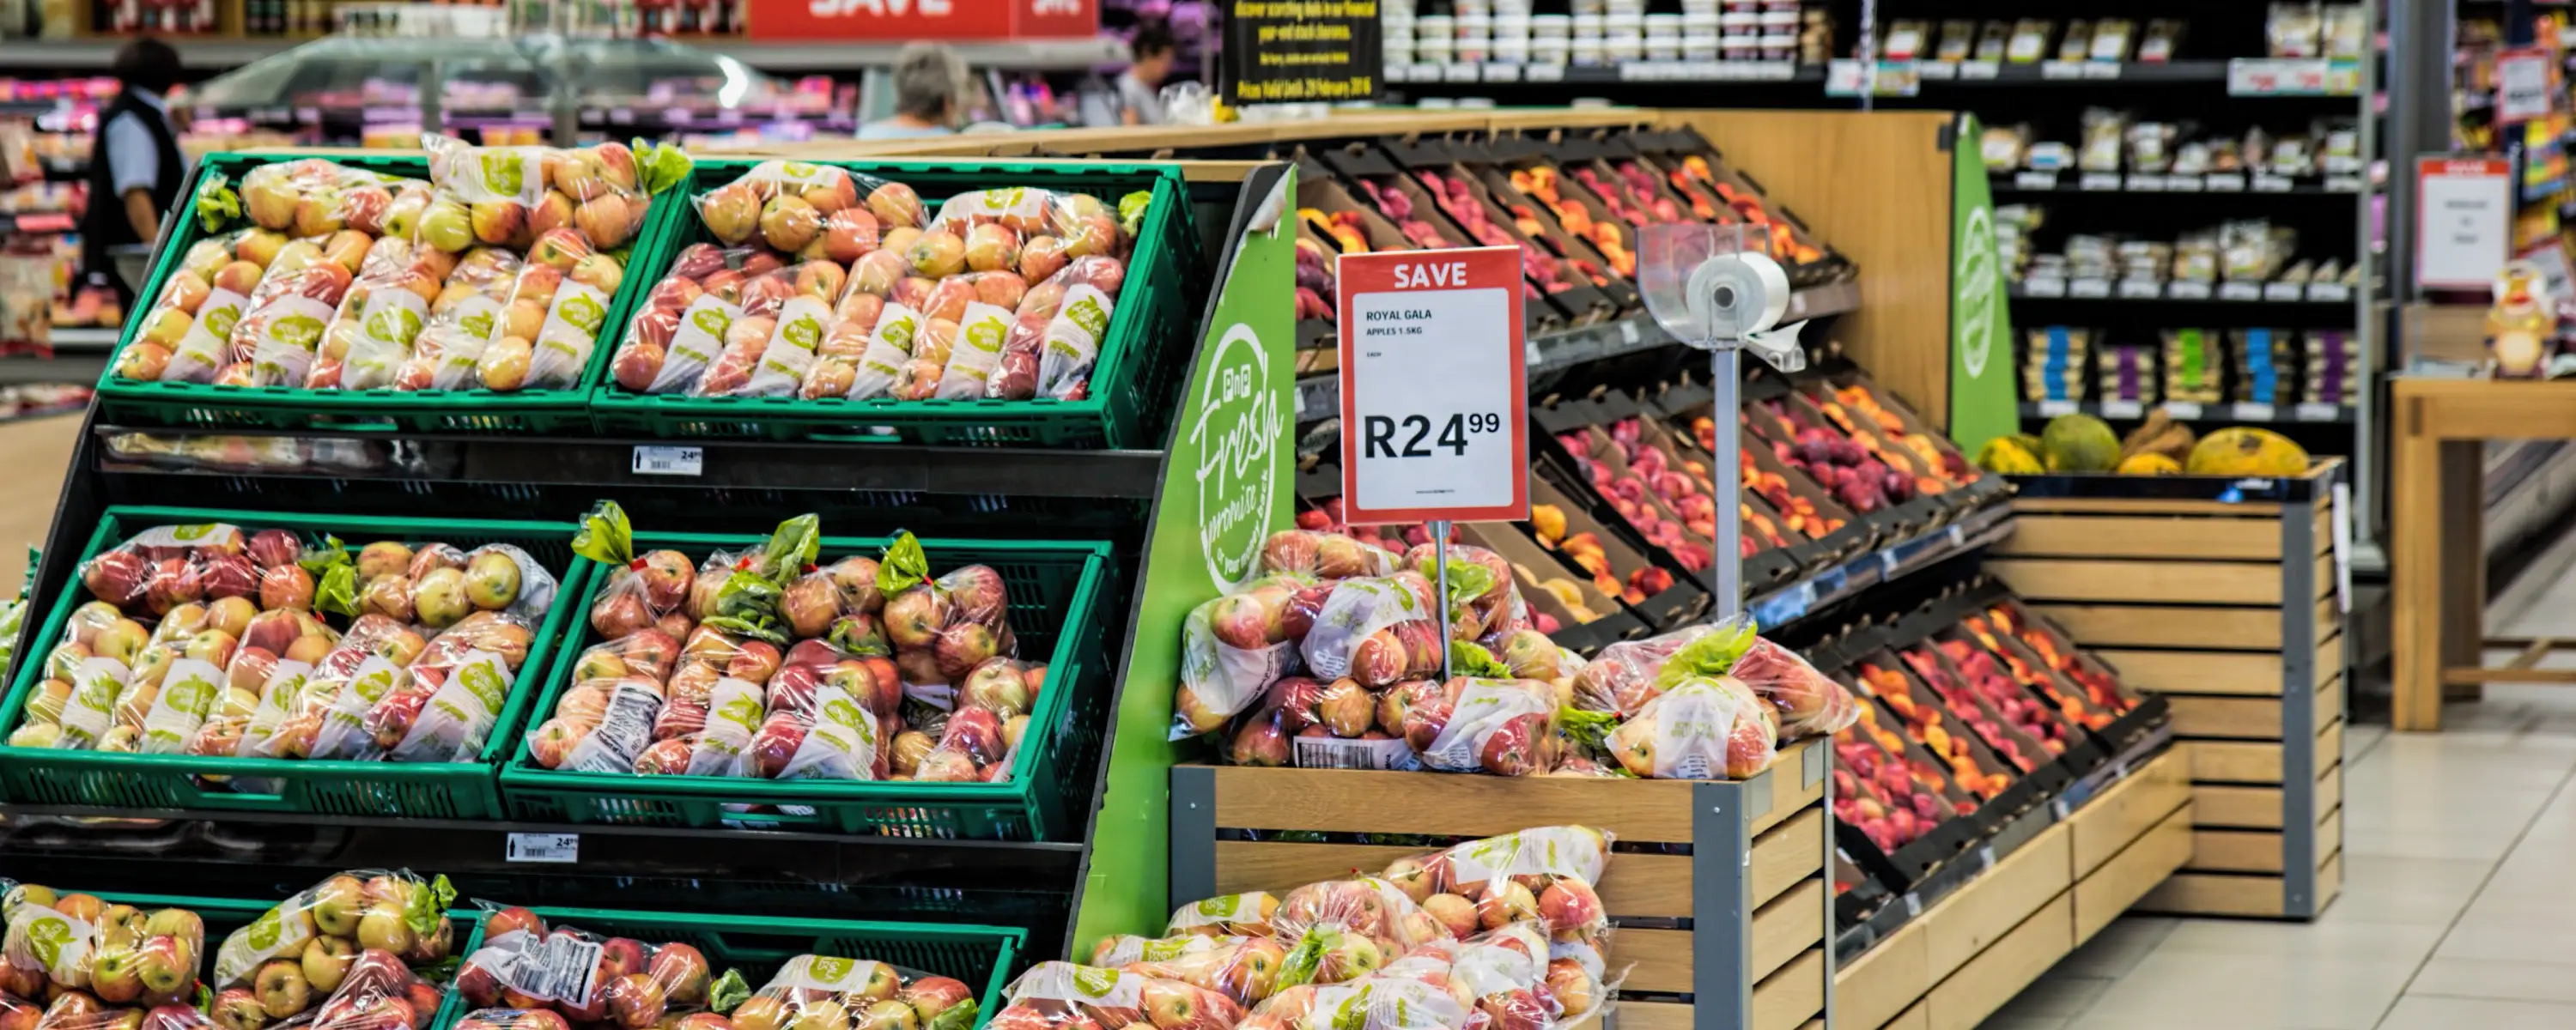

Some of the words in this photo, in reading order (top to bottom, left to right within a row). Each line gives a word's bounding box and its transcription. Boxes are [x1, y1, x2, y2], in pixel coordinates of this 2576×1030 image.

[1394, 261, 1467, 288] SAVE
[1366, 310, 1401, 322] ROYAL
[1404, 309, 1432, 320] GALA
[1366, 327, 1396, 336] APPLES
[1399, 326, 1423, 335] 1.5KG
[1189, 352, 1285, 500] Fresh
[1206, 483, 1257, 571] promise
